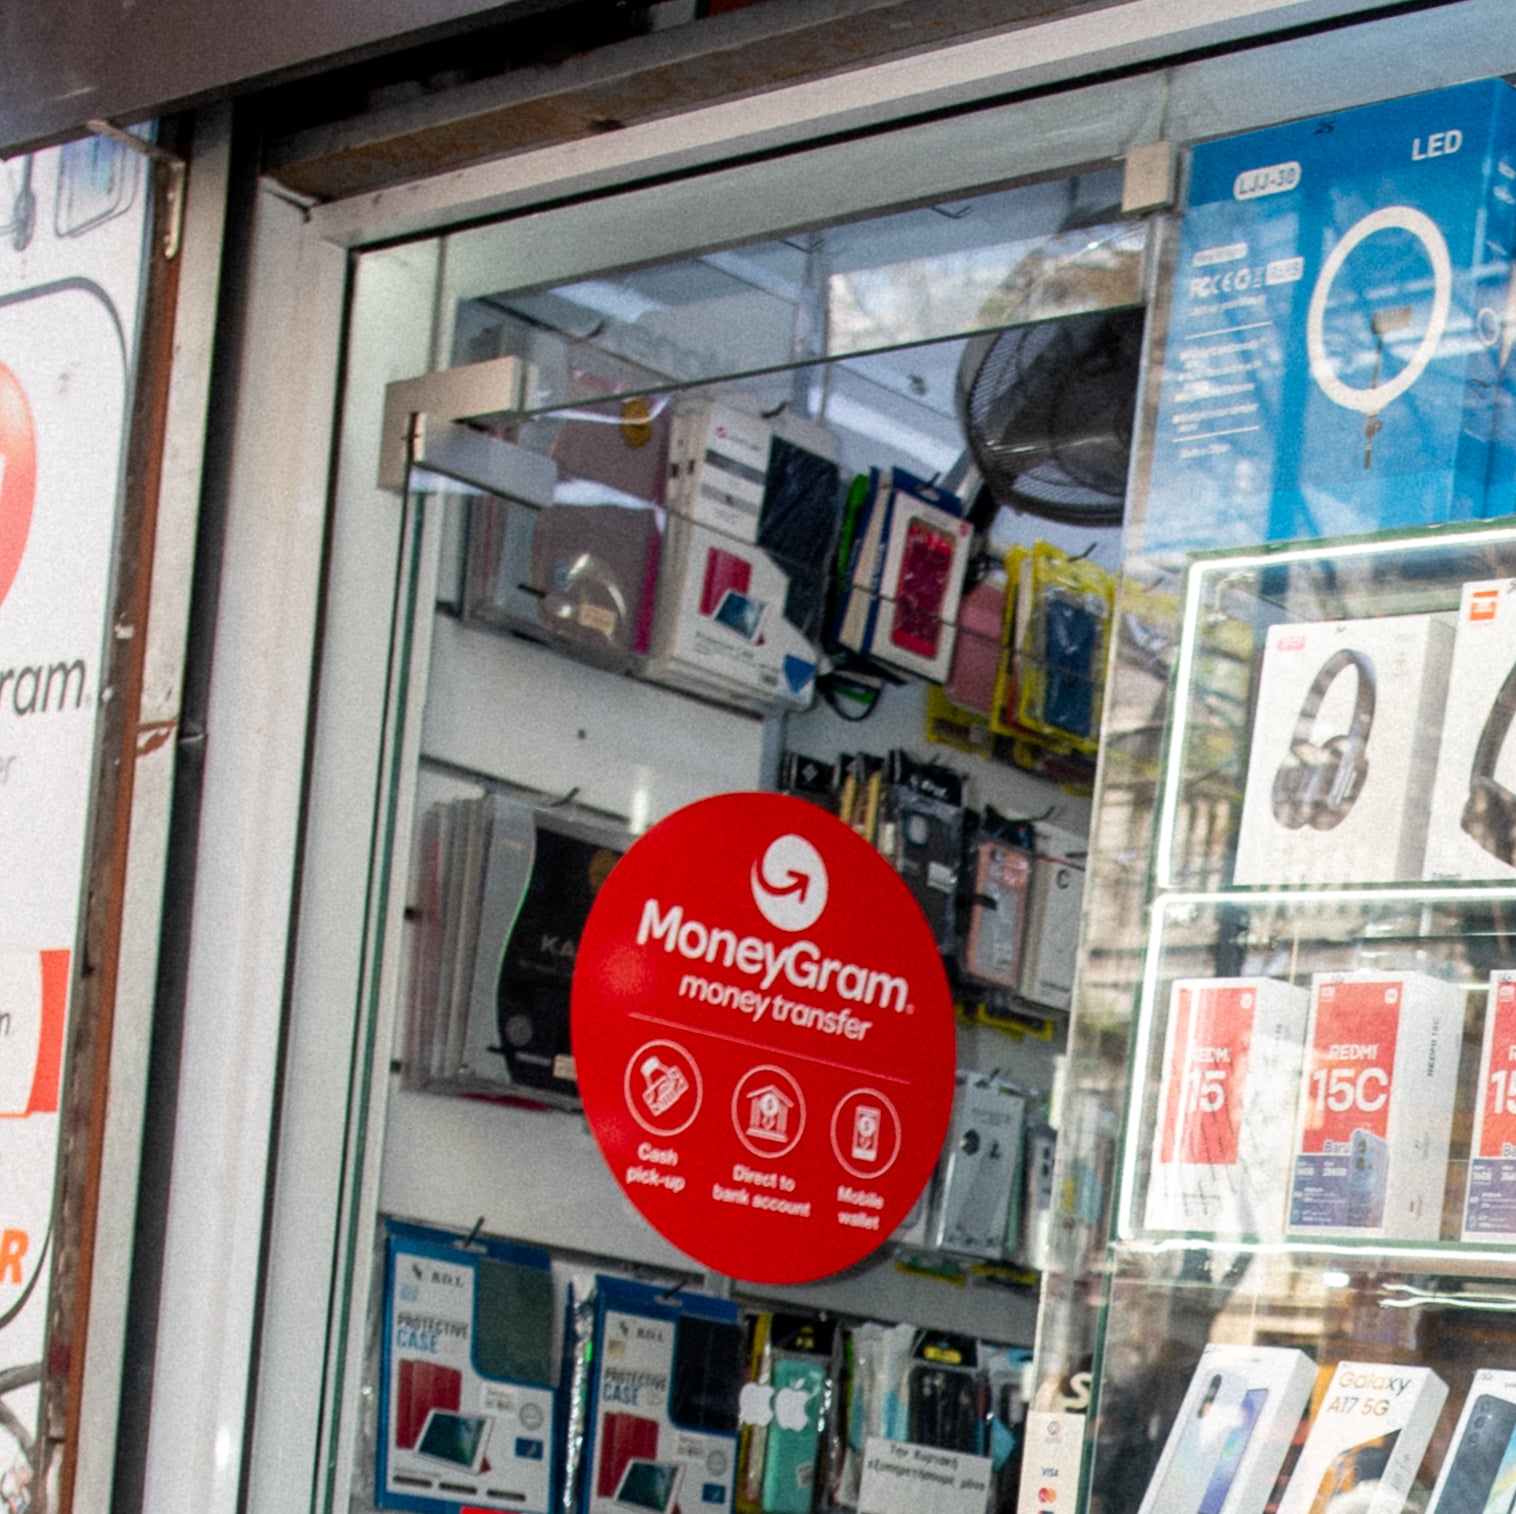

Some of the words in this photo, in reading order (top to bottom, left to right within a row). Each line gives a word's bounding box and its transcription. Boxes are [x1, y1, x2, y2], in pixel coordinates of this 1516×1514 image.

[1411, 129, 1463, 161] LED
[636, 898, 910, 1013] MoneyGram
[679, 974, 769, 1022] money
[771, 994, 872, 1041] transfer
[1330, 1044, 1379, 1061] REDMI
[1312, 1067, 1389, 1113] 15C
[637, 1142, 679, 1168] Cash
[626, 1165, 686, 1194] pick-up
[733, 1164, 774, 1191] Direct
[779, 1174, 796, 1194] to
[713, 1184, 749, 1207] bank
[753, 1194, 811, 1218] account
[837, 1185, 884, 1211] Mobile
[838, 1206, 880, 1232] wallet
[397, 1313, 469, 1340] PROTECTIVE
[396, 1328, 438, 1353] CASE
[604, 1366, 668, 1392] PROTECTIVE
[1339, 1369, 1412, 1397] Galaxy
[602, 1382, 639, 1406] CASE
[1327, 1395, 1358, 1416] A17
[1361, 1398, 1390, 1418] 5G
